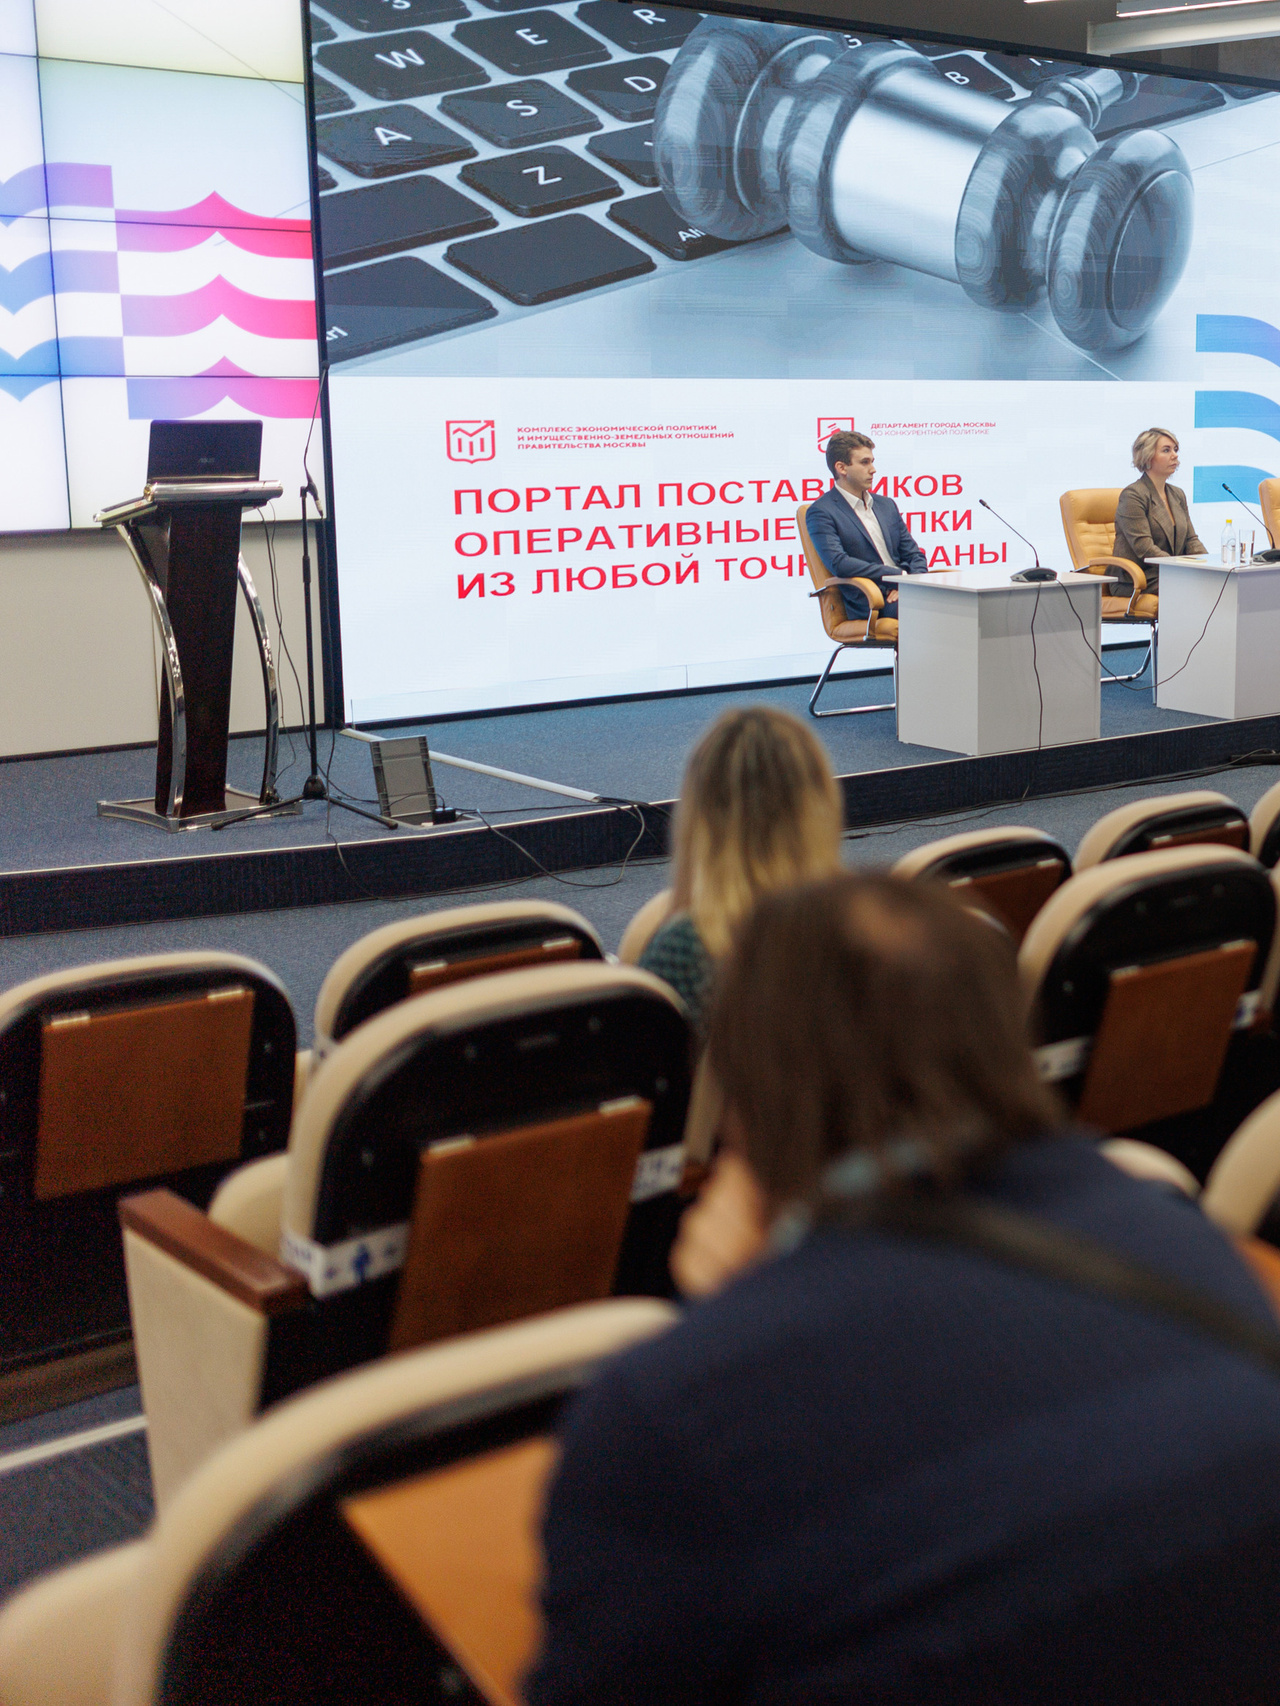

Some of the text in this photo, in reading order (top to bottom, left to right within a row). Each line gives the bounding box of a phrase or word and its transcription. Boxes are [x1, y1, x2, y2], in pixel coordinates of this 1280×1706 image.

[632, 8, 666, 25] R
[515, 28, 548, 46] E
[374, 48, 425, 69] W
[623, 76, 657, 92] D
[940, 71, 970, 85] B
[506, 99, 539, 117] S
[374, 126, 412, 146] A
[522, 165, 562, 185] Z
[527, 433, 673, 441] ИМУЩЕСТВЕННО-ЗЕМЕЛЬНЫХ
[674, 431, 734, 439] ОТНОШЕНИЙ
[575, 424, 664, 432] ЭКОНОМИЧЕСКОЙ
[454, 474, 963, 515] ПОРТАЛ ПОСТАВИКОВ
[454, 518, 797, 557] ОПЕРАТИВНЫЕ
[457, 571, 516, 599] ИЗ
[532, 552, 699, 594] ЛЮБОЙ
[715, 555, 807, 581] ТОЧ
